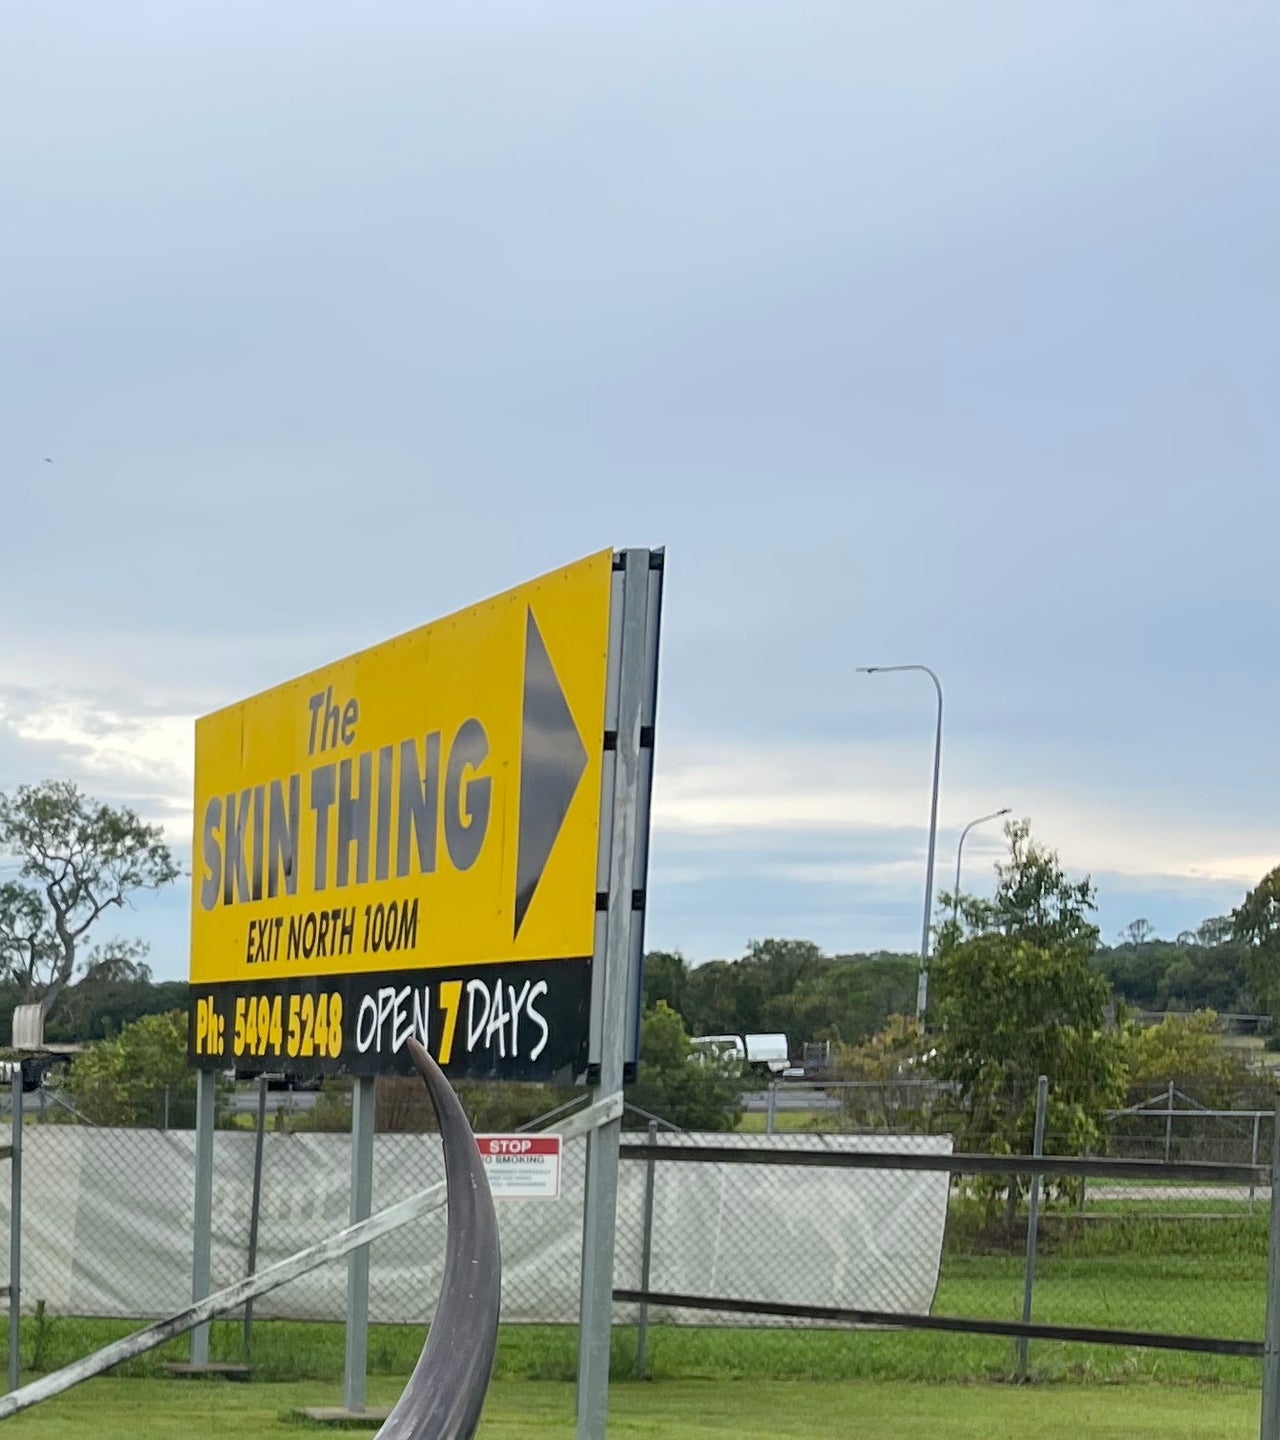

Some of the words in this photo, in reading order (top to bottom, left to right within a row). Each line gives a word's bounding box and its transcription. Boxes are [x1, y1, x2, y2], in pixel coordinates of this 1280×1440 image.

[308, 684, 359, 756] The
[200, 773, 301, 911] SKIN
[310, 717, 493, 891] THING
[246, 916, 284, 964] EXIT
[286, 906, 356, 960] NORTH
[362, 898, 419, 953] 100M
[196, 995, 225, 1056] Ph:
[234, 995, 283, 1057] 5494
[287, 991, 343, 1059] 5248
[356, 985, 430, 1055] OPEN
[439, 979, 464, 1065] 7
[466, 977, 549, 1062] DAYS
[488, 1139, 532, 1153] STOP
